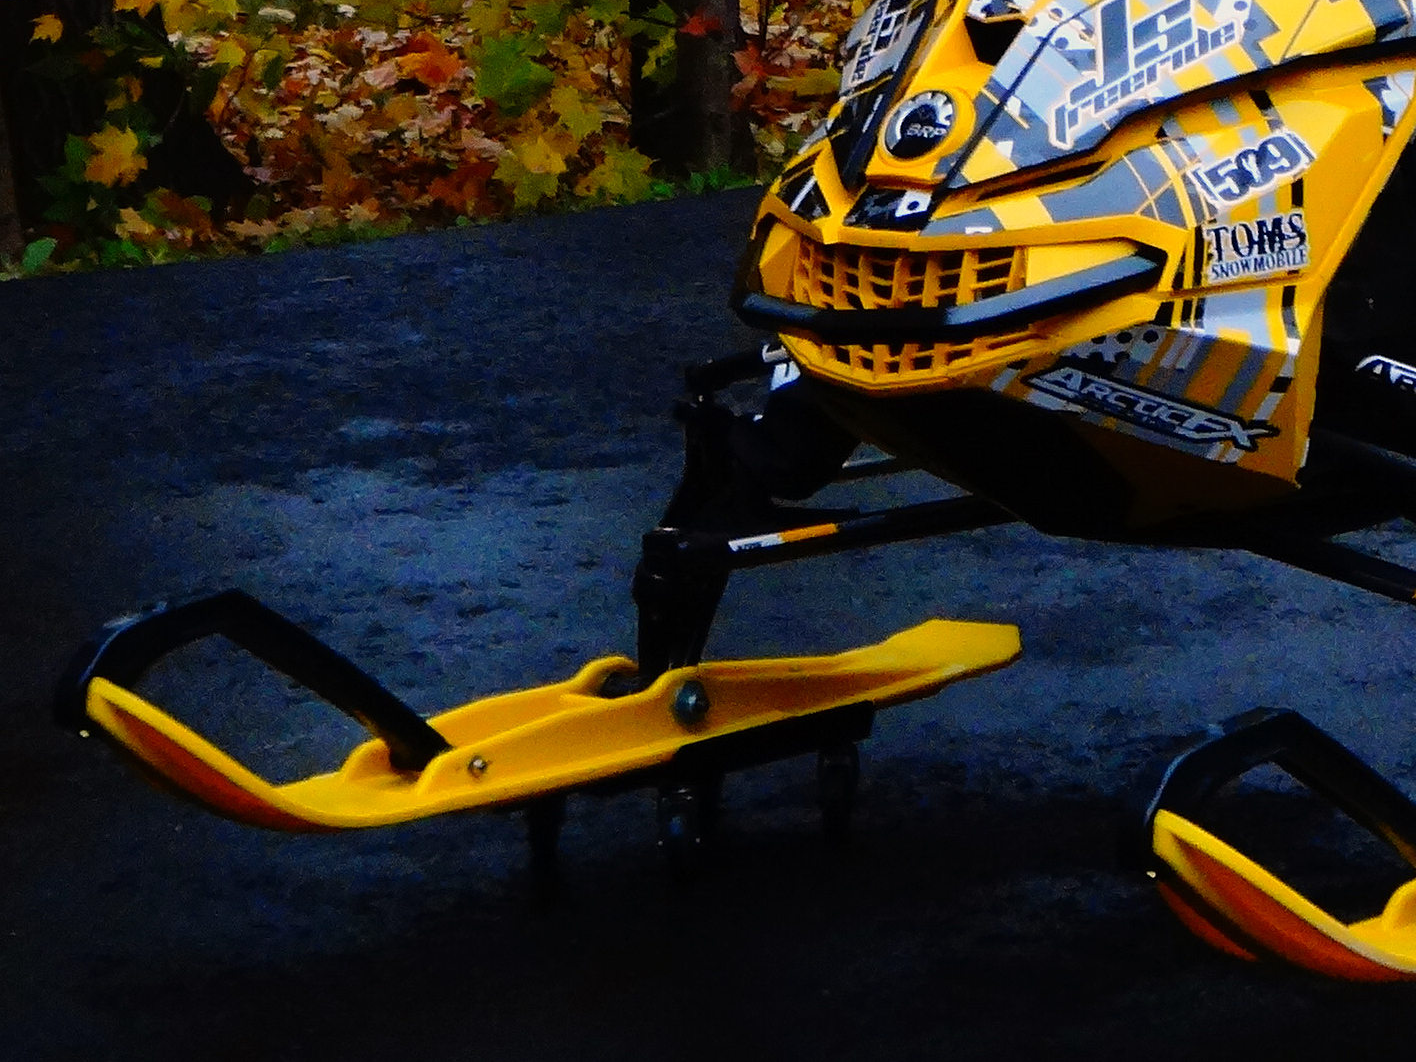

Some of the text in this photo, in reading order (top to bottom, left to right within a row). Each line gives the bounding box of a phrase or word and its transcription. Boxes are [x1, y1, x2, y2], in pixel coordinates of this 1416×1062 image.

[1202, 136, 1303, 202] 509
[1206, 213, 1306, 262] TOMS
[1211, 247, 1307, 280] SNOWMOBILE
